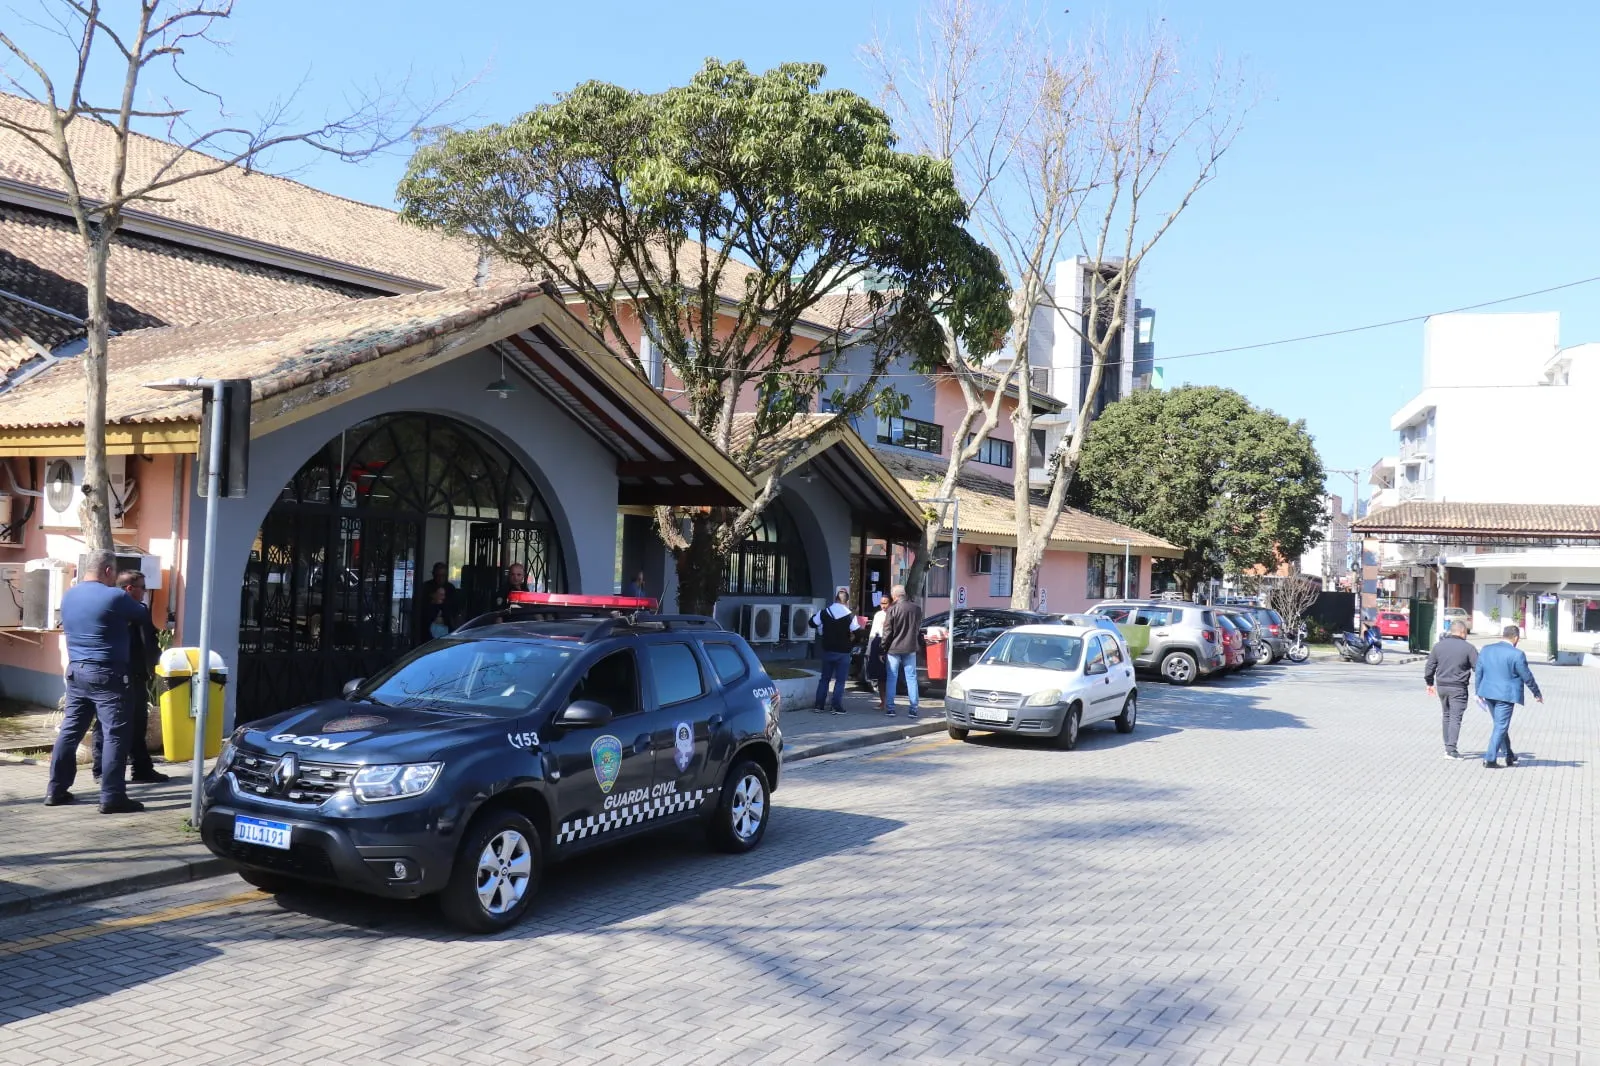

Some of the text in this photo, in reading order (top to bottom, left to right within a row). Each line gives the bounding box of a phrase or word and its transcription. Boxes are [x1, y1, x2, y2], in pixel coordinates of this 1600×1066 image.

[752, 687, 769, 698] GCM
[270, 733, 348, 751] GCM
[515, 731, 540, 747] 153
[603, 780, 677, 810] GUARDA CIVIL
